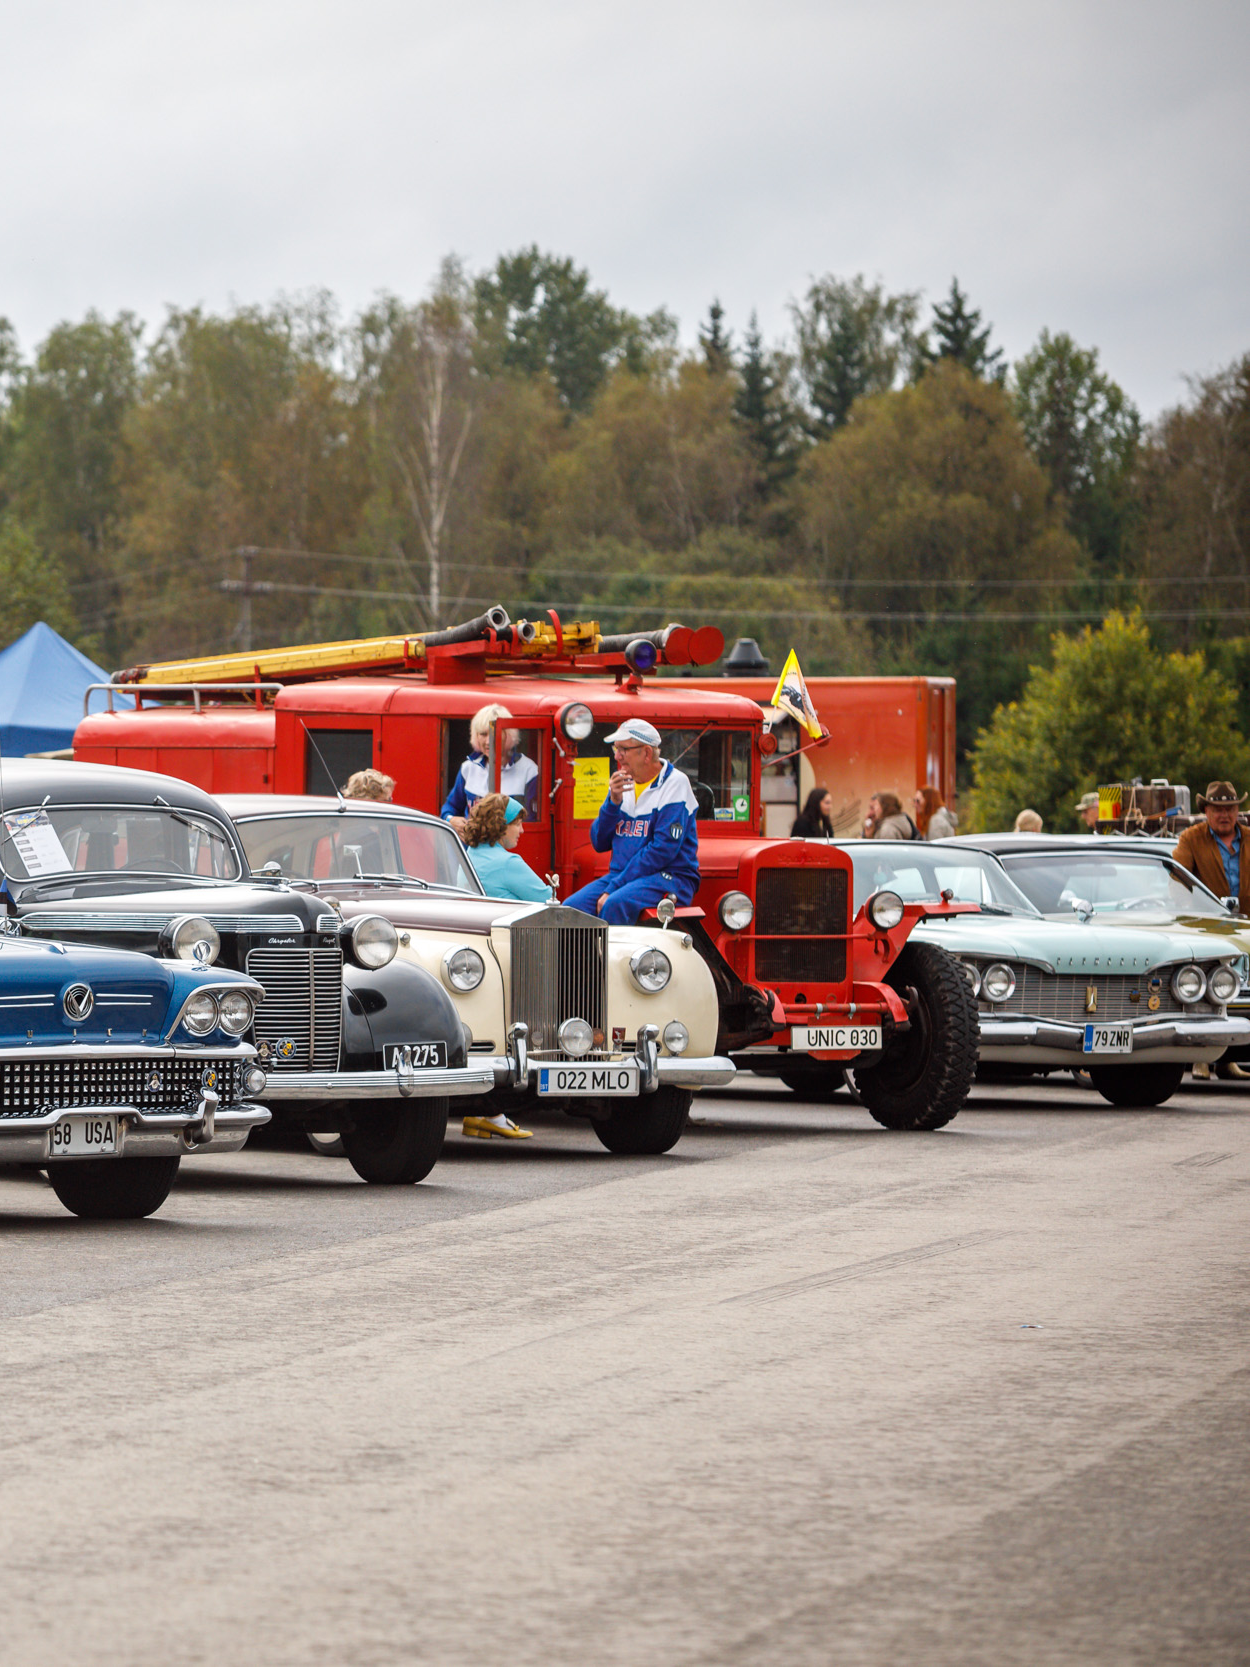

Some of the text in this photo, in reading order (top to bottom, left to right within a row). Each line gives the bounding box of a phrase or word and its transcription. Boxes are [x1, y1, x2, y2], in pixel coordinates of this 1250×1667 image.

[807, 1029, 878, 1047] UNIC 030
[391, 1044, 439, 1068] A 275
[557, 1071, 630, 1090] 022 MLO
[54, 1121, 114, 1146] 58 USA
